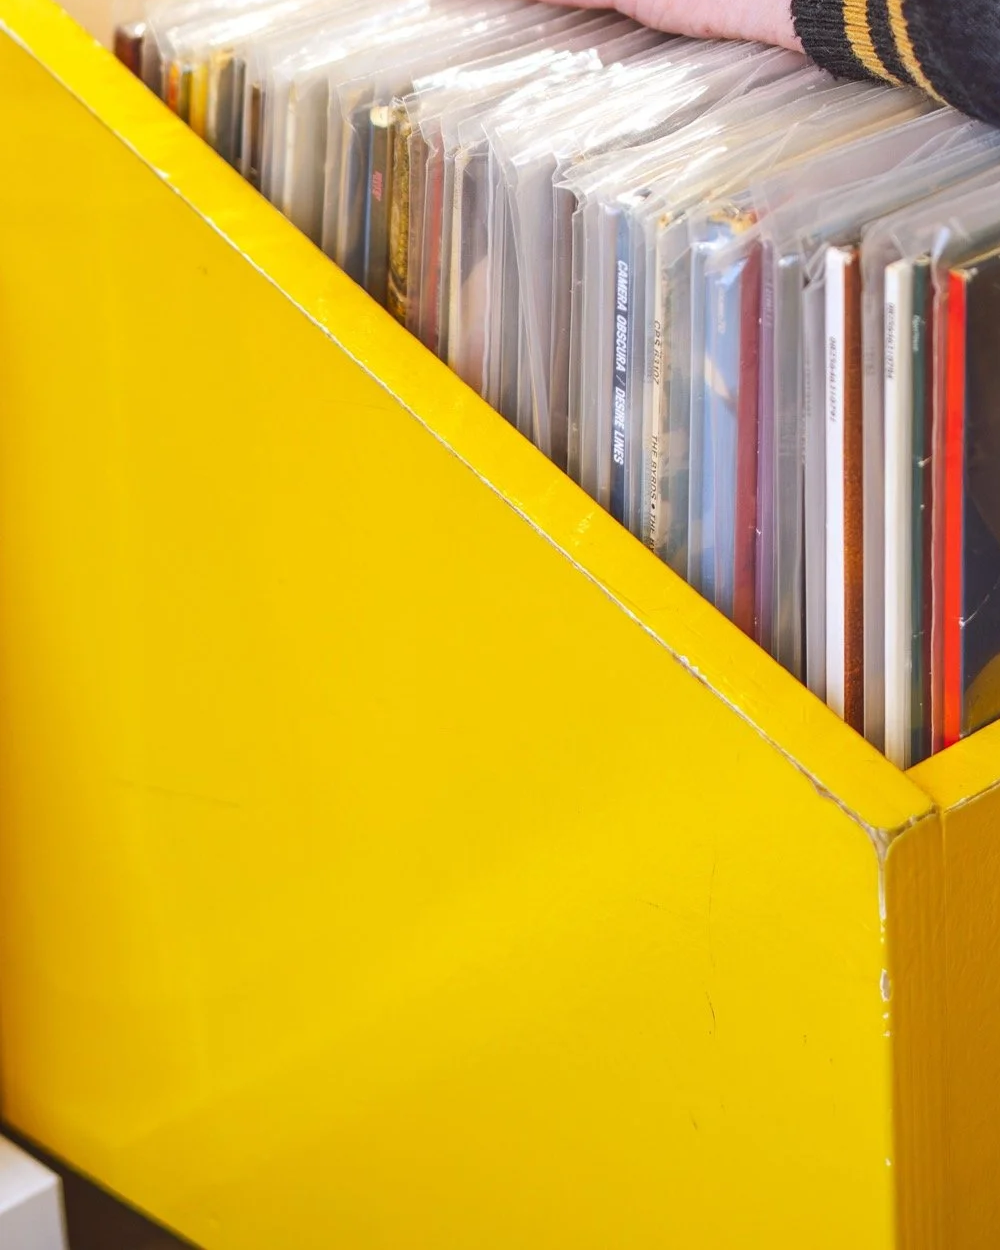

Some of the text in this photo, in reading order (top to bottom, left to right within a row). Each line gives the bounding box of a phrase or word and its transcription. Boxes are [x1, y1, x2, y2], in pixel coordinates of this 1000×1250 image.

[616, 259, 629, 312] CAMERA
[615, 313, 628, 373] OBSCURA
[613, 386, 626, 430] DESIRE
[613, 430, 625, 466] LINES
[649, 461, 659, 501] BYRDS
